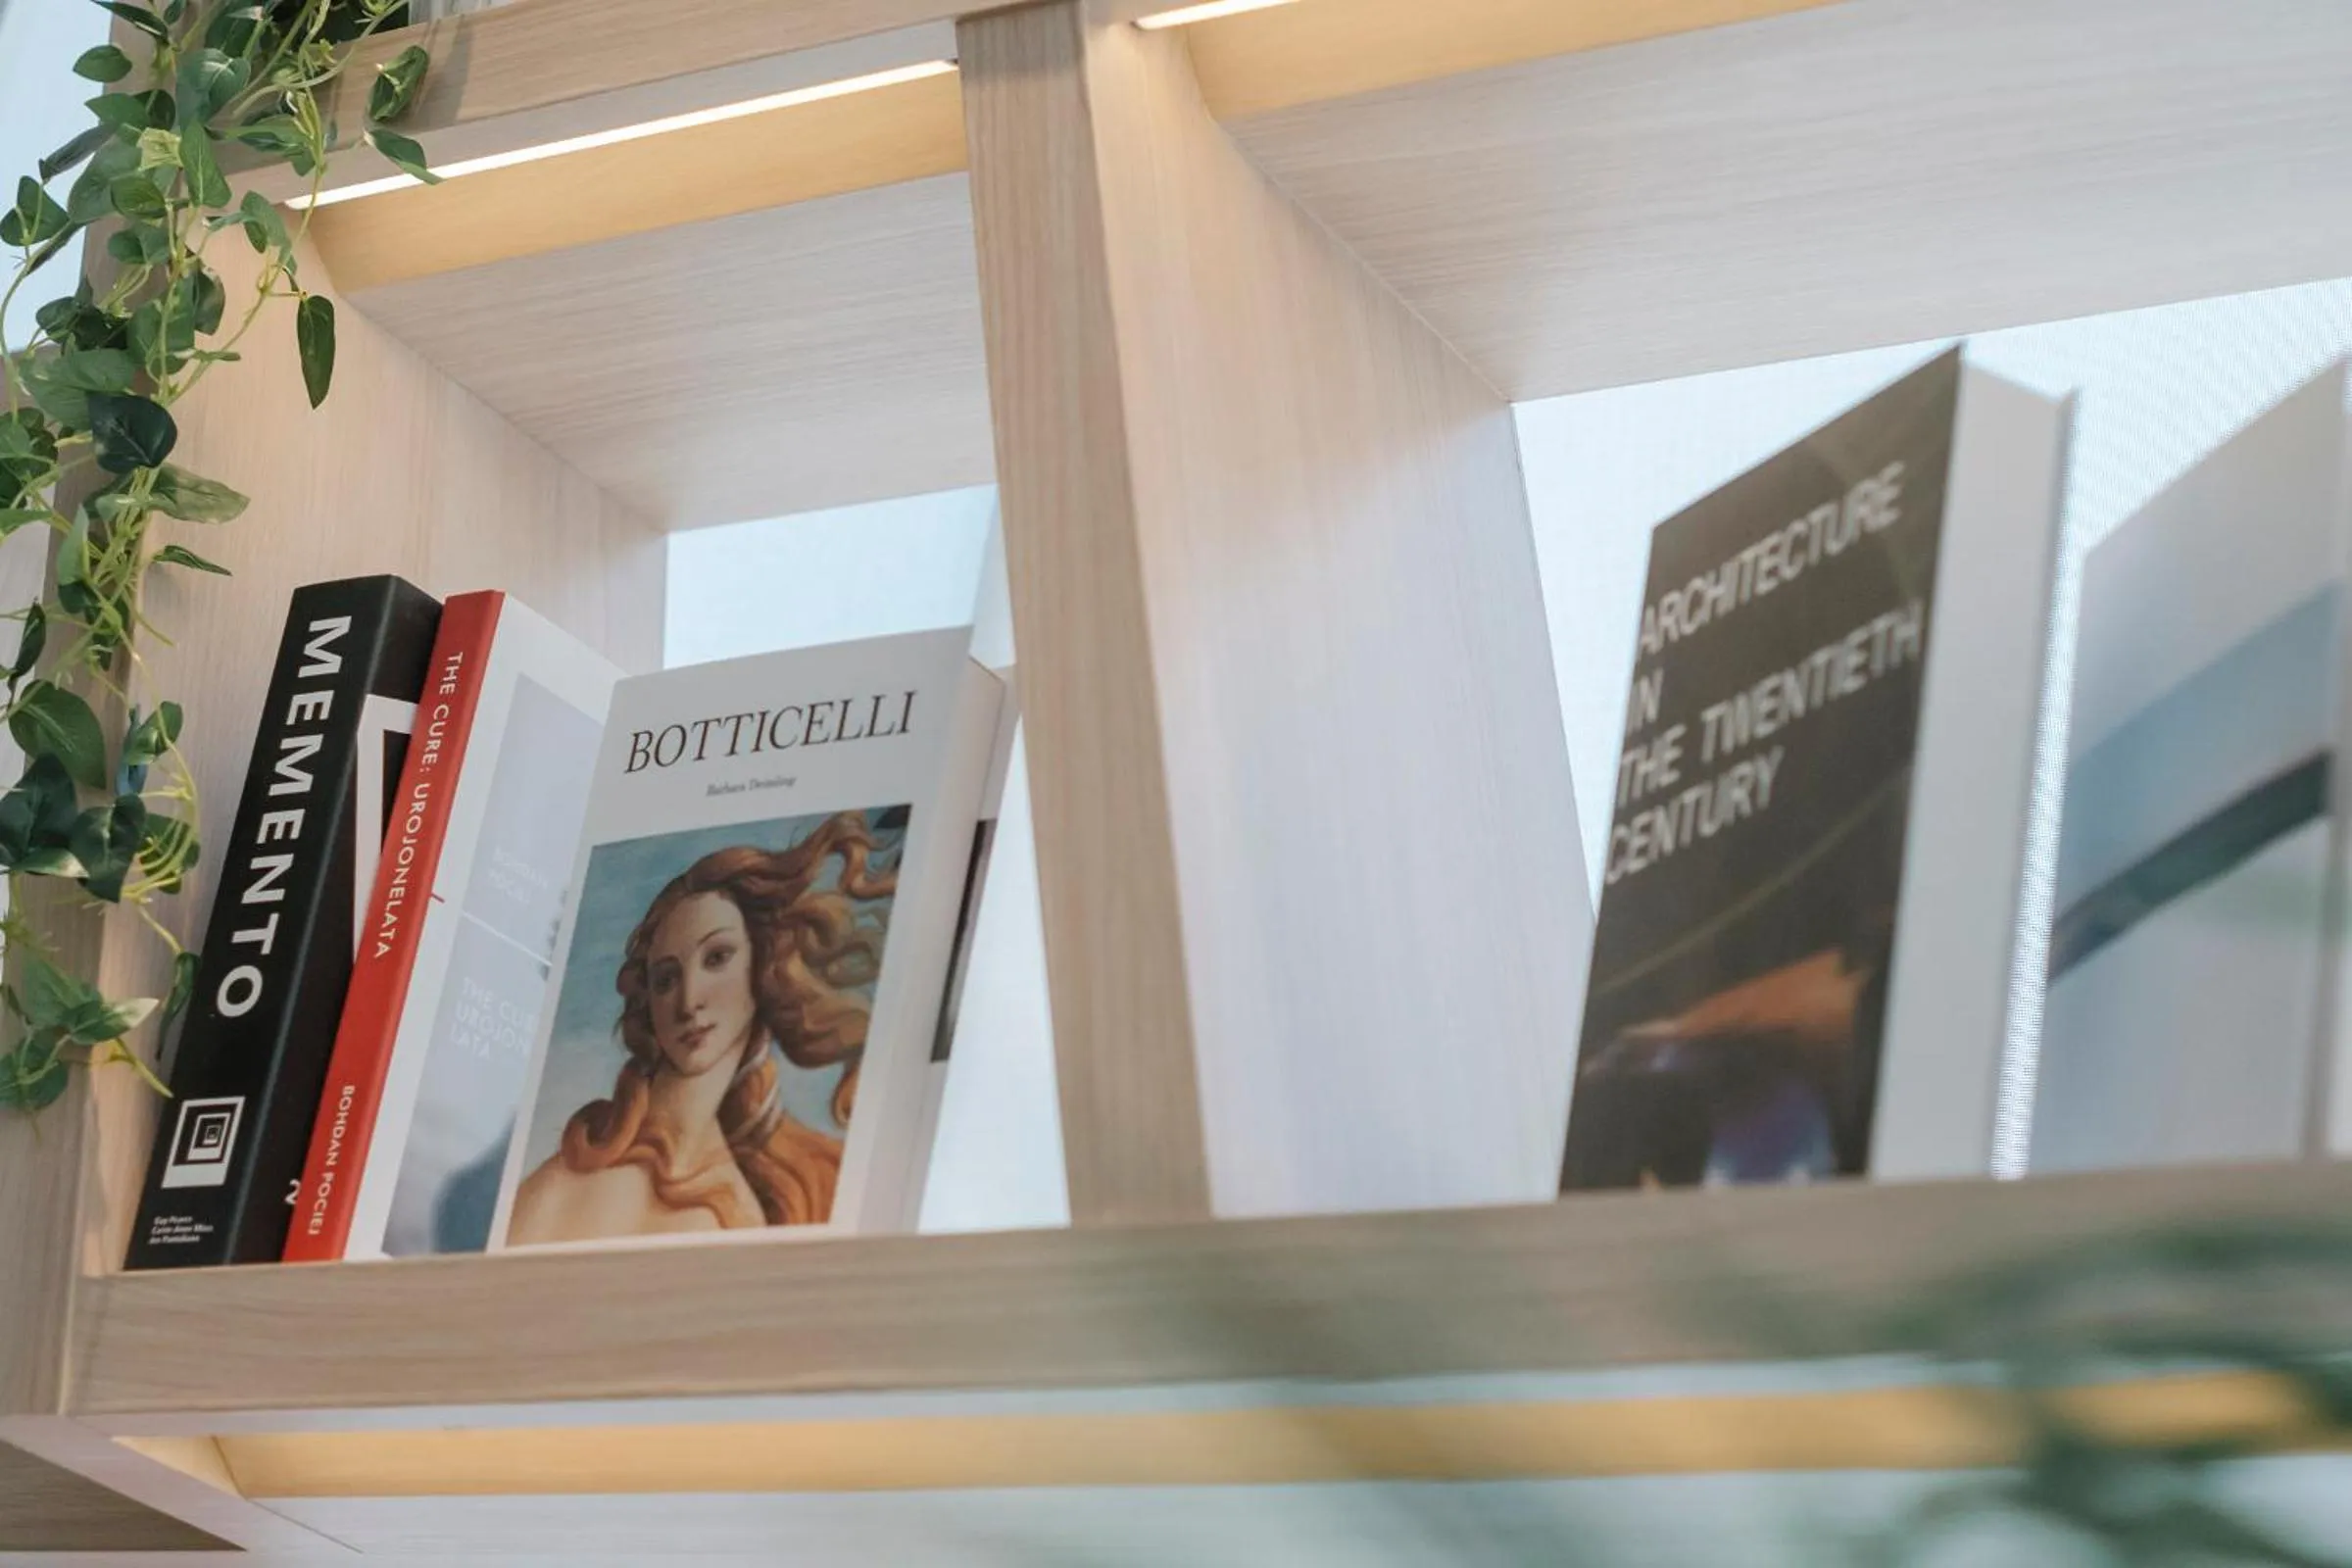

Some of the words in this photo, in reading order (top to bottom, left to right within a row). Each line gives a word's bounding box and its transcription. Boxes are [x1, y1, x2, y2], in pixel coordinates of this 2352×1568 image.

[1637, 460, 1906, 661] ARCHITECTURE
[438, 651, 465, 696] THE
[1616, 722, 1687, 809] THE
[1700, 596, 1924, 763] TWENTIETH
[419, 703, 451, 773] CURE:
[623, 689, 918, 774] BOTTICELLI
[217, 615, 352, 1017] MEMENTO
[1605, 745, 1786, 885] CENTURY
[325, 1085, 355, 1168] BOHDAN
[307, 1171, 334, 1236] POCIEJ
